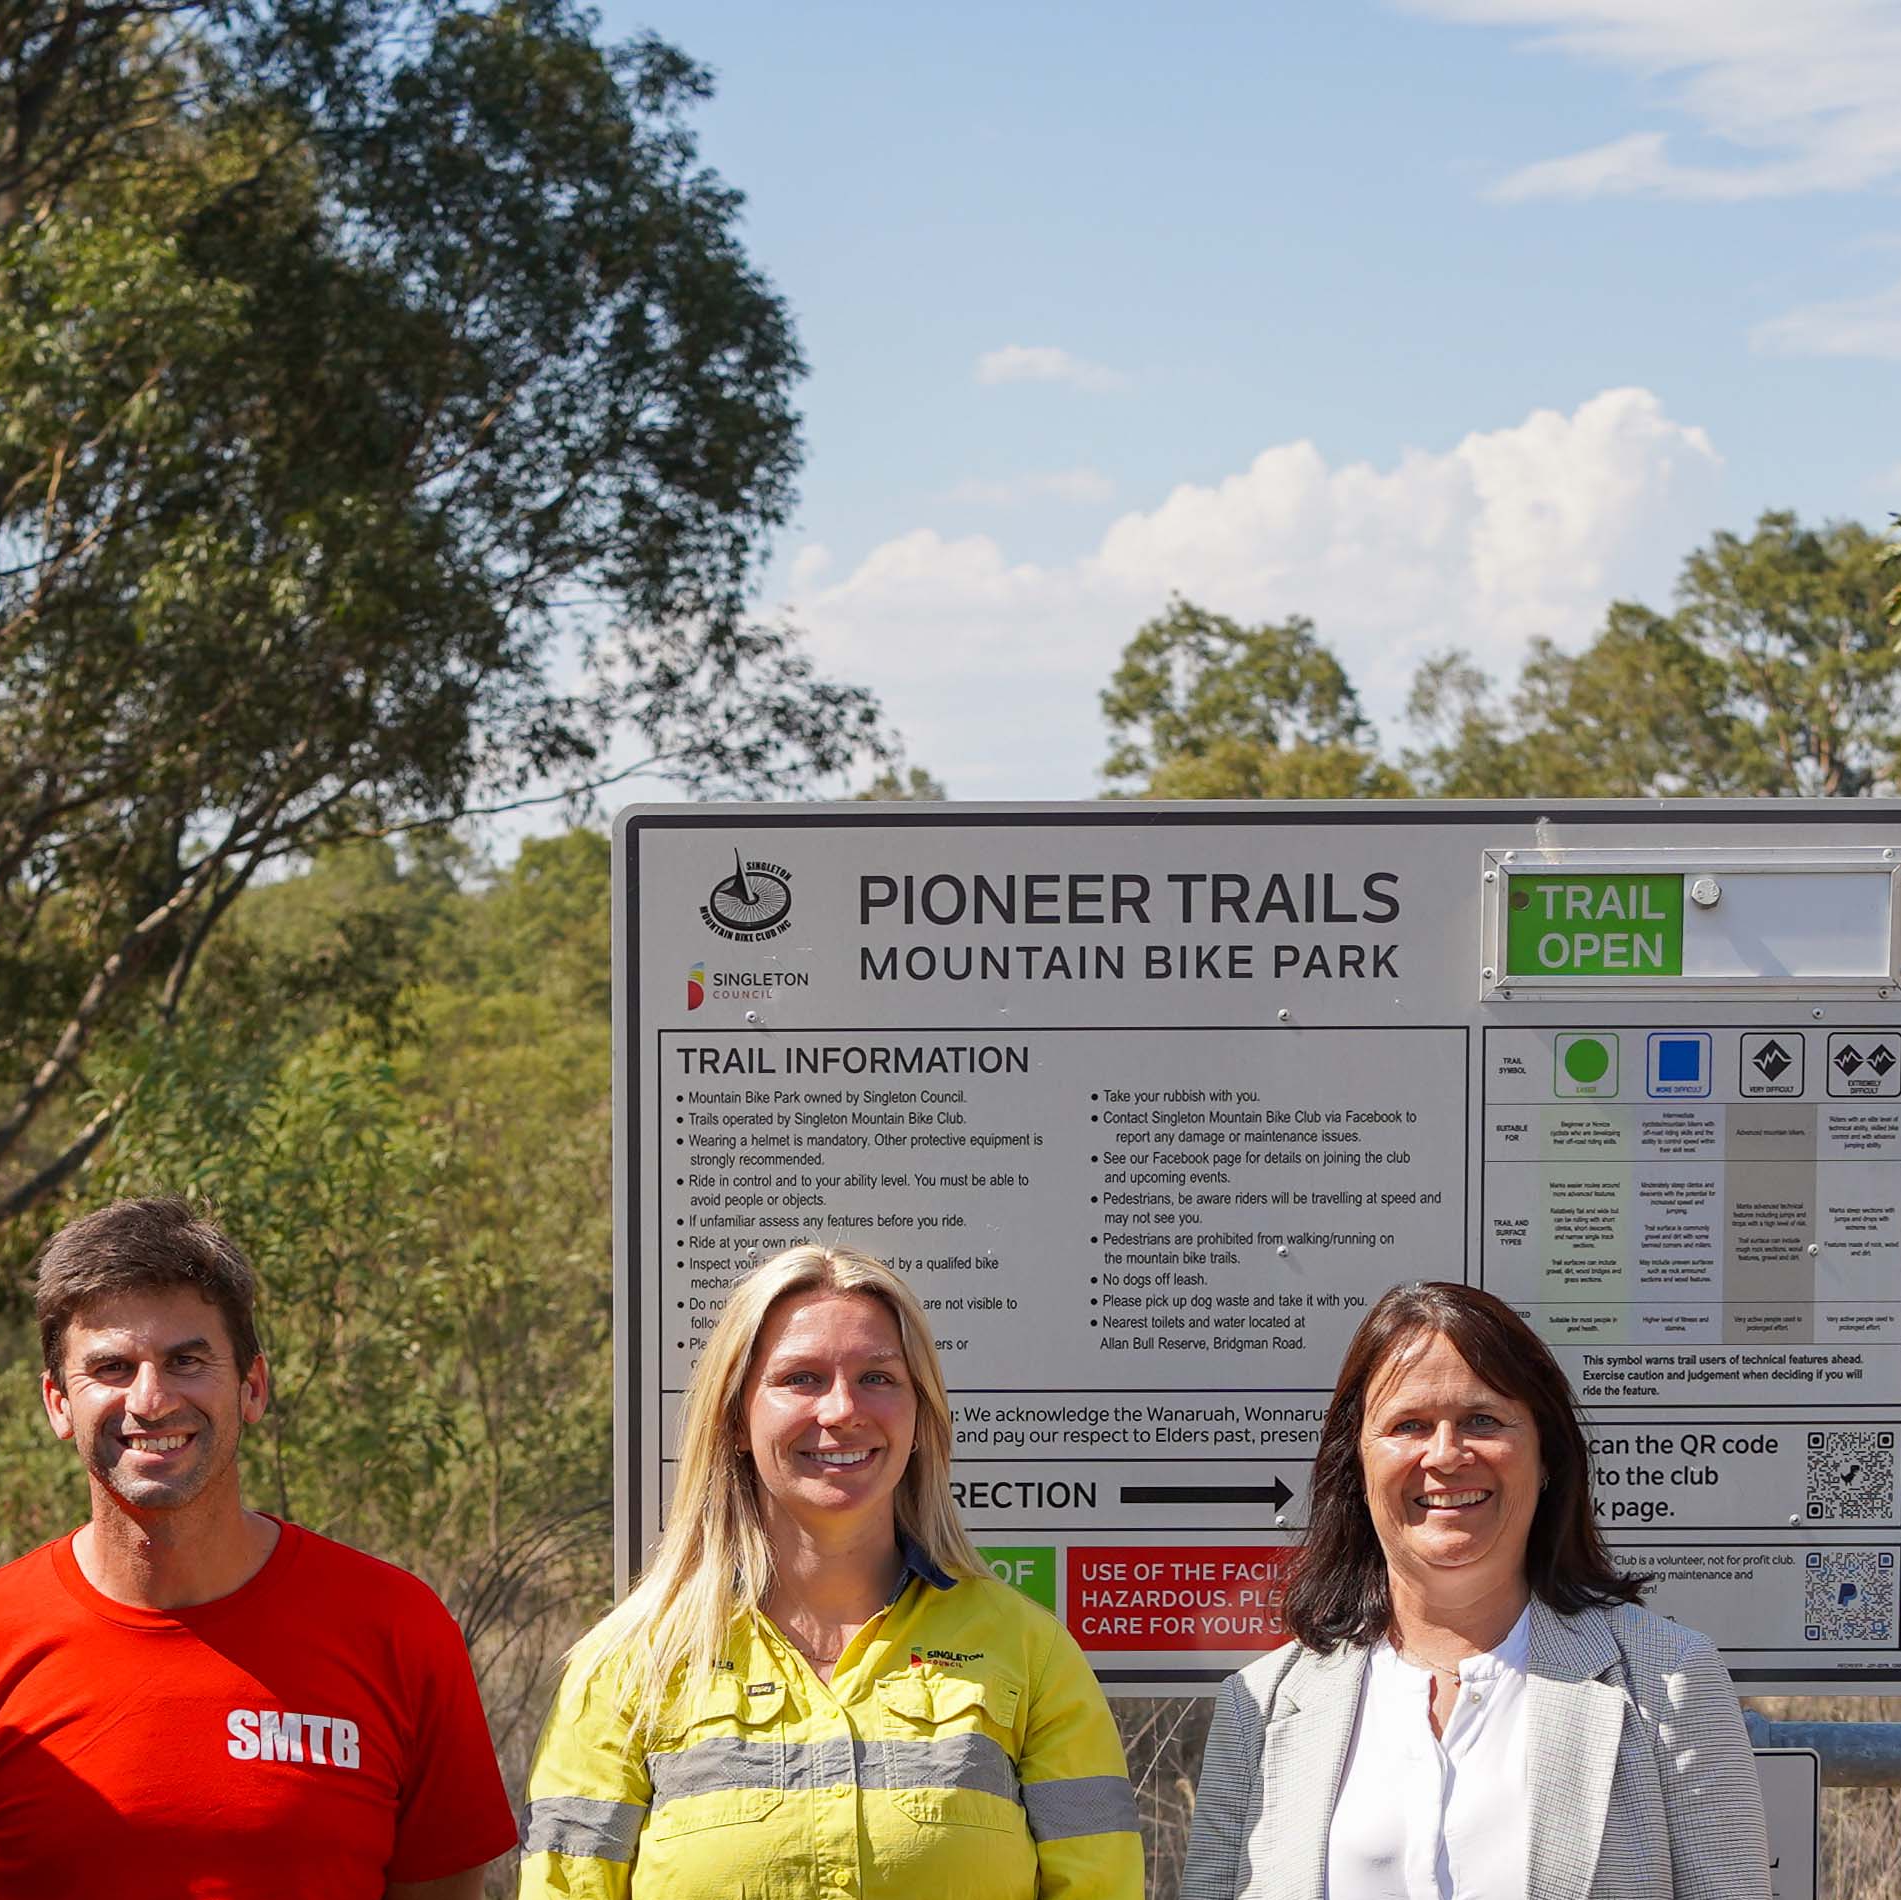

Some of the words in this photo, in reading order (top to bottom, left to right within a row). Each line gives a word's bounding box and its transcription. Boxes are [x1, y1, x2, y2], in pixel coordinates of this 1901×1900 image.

[746, 861, 793, 882] SINGLETON
[860, 873, 1151, 926] PIONEER
[1167, 871, 1400, 924] TRAILS
[1536, 884, 1667, 924] TRAIL
[699, 905, 733, 940] MOUNTAIN
[735, 933, 754, 943] BIKE
[755, 928, 777, 942] CLUB
[778, 919, 792, 935] INC
[1537, 932, 1663, 969] OPEN
[860, 945, 1124, 981] MOUNTAIN
[1145, 944, 1253, 980] BIKE
[1273, 944, 1400, 979] PARK
[713, 972, 809, 987] SINGLETON
[712, 989, 773, 1000] COUNCIL
[675, 1047, 777, 1075] TRAIL
[786, 1045, 1029, 1074] INFORMATION
[688, 1090, 742, 1105] Mountain
[745, 1090, 771, 1104] Bike
[773, 1090, 801, 1104] Park
[803, 1090, 843, 1104] owned
[845, 1090, 860, 1107] by
[863, 1090, 917, 1107] Singleton
[920, 1089, 967, 1104] Council.
[1103, 1110, 1149, 1124] Contact
[1151, 1110, 1206, 1127] Singleton
[1208, 1110, 1263, 1124] Mountain
[1265, 1110, 1291, 1124] Bike
[1294, 1109, 1322, 1124] Club
[1324, 1110, 1342, 1124] via
[1345, 1109, 1403, 1123] Facebook
[1405, 1111, 1418, 1124] to
[688, 1133, 737, 1150] Wearing
[739, 1136, 748, 1147] a
[750, 1133, 791, 1147] helmet
[793, 1133, 804, 1147] is
[806, 1133, 871, 1150] mandatory.
[874, 1132, 908, 1146] Other
[910, 1132, 967, 1149] protective
[969, 1132, 1031, 1149] equipment
[1033, 1132, 1044, 1146] is
[1115, 1130, 1151, 1146] report
[1153, 1132, 1176, 1146] any
[1177, 1130, 1226, 1146] damage
[1228, 1132, 1242, 1143] or
[1244, 1129, 1318, 1143] maintenance
[1321, 1129, 1362, 1143] issues.
[1504, 1134, 1520, 1142] FOR
[690, 1152, 736, 1169] strongly
[739, 1152, 825, 1166] recommended.
[1495, 1228, 1527, 1237] SURFACE
[1499, 1238, 1522, 1246] TYPES
[1099, 1336, 1129, 1350] Allan
[1132, 1336, 1155, 1350] Bull
[1157, 1336, 1210, 1351] Reserve,
[1213, 1336, 1269, 1353] Bridgman
[1272, 1336, 1306, 1350] Road.
[1582, 1354, 1605, 1366] This
[1606, 1354, 1643, 1368] symbol
[1644, 1356, 1676, 1366] warns
[1677, 1354, 1697, 1366] trail
[1698, 1356, 1727, 1365] users
[1728, 1354, 1740, 1365] of
[1741, 1353, 1787, 1365] technical
[1788, 1353, 1829, 1365] features
[1831, 1353, 1864, 1364] ahead.
[1582, 1369, 1627, 1381] Exercise
[1626, 1369, 1665, 1381] caution
[1666, 1369, 1686, 1381] and
[1686, 1369, 1741, 1383] judgement
[1741, 1369, 1769, 1380] when
[1770, 1369, 1814, 1383] deciding
[1816, 1368, 1824, 1380] if
[1824, 1371, 1844, 1383] you
[1845, 1368, 1863, 1380] will
[1582, 1385, 1602, 1396] ride
[1604, 1384, 1621, 1396] the
[1622, 1384, 1660, 1396] feature.
[963, 1406, 991, 1423] We
[995, 1406, 1110, 1426] acknowledge
[1113, 1406, 1143, 1422] the
[1146, 1406, 1240, 1424] Wanaruah,
[956, 1427, 989, 1444] and
[993, 1430, 1025, 1448] pay
[1029, 1430, 1060, 1443] our
[1063, 1428, 1130, 1446] respect
[1132, 1428, 1151, 1443] to
[1155, 1427, 1210, 1443] Elders
[1213, 1427, 1256, 1446] past,
[1260, 1430, 1322, 1446] presen
[1588, 1439, 1630, 1455] can
[1634, 1434, 1674, 1455] the
[1680, 1434, 1716, 1458] QR
[1722, 1434, 1779, 1455] code
[1595, 1466, 1621, 1486] to
[1625, 1465, 1665, 1486] the
[1670, 1465, 1719, 1486] club
[949, 1481, 1097, 1509] RECTION
[1611, 1501, 1675, 1523] page.
[1614, 1554, 1637, 1566] Club
[1638, 1554, 1647, 1566] is
[1648, 1556, 1655, 1566] a
[1656, 1554, 1706, 1567] volunteer,
[1707, 1555, 1725, 1566] not
[1726, 1554, 1742, 1566] for
[1742, 1554, 1771, 1567] profit
[1771, 1554, 1796, 1565] club.
[1082, 1563, 1127, 1581] USE
[1133, 1563, 1165, 1581] OF
[1169, 1563, 1216, 1581] THE
[1667, 1569, 1733, 1580] maintenance
[1733, 1569, 1754, 1580] and
[1081, 1590, 1233, 1609] HAZARDOUS.
[1081, 1616, 1143, 1635] CARE
[1149, 1616, 1196, 1635] FOR
[1200, 1616, 1264, 1635] YOUR
[927, 1650, 984, 1662] SINGLETON
[927, 1659, 963, 1668] COUNCIL
[227, 1709, 360, 1769] SMTB
